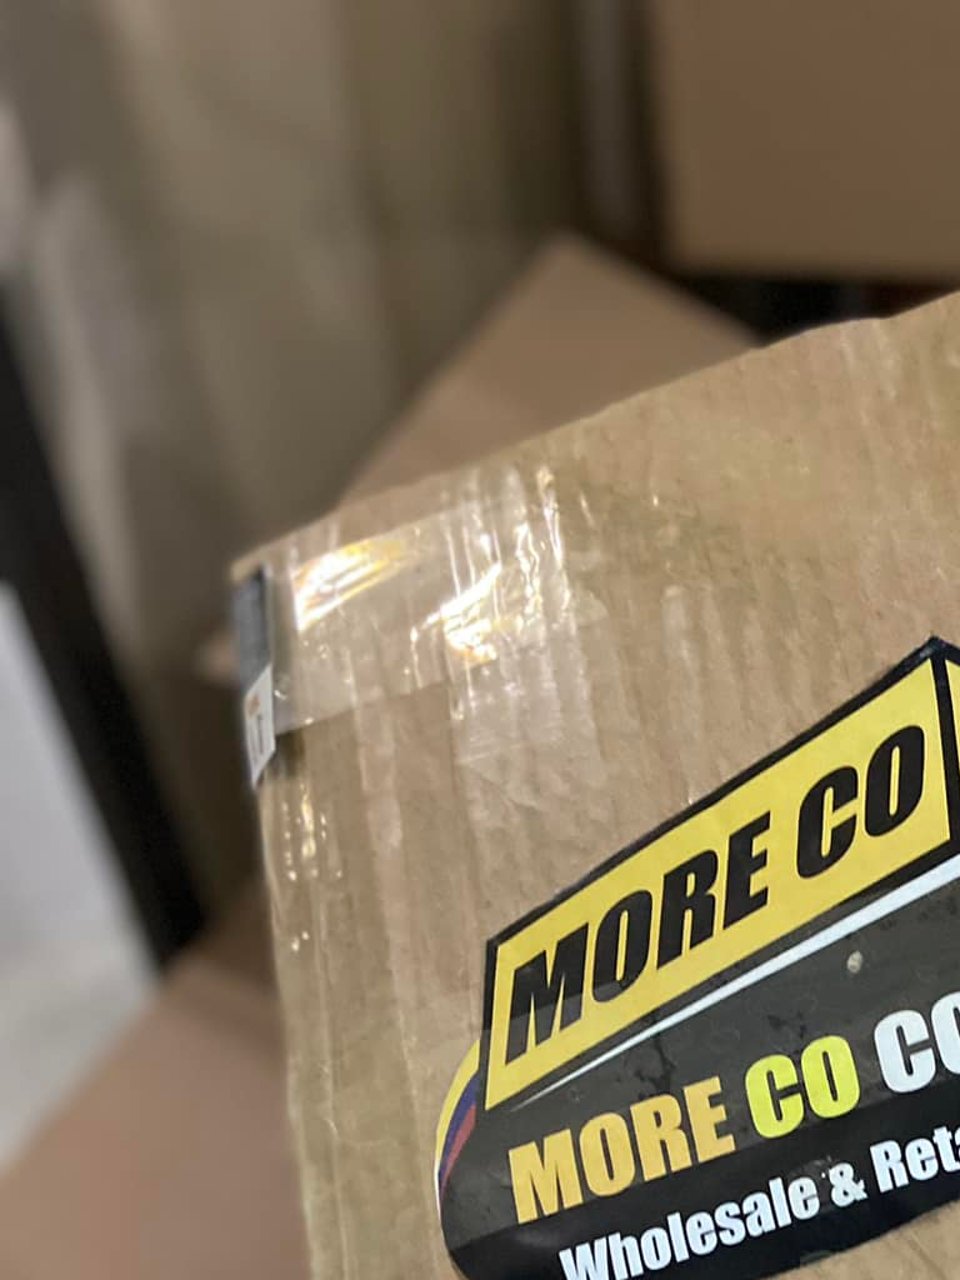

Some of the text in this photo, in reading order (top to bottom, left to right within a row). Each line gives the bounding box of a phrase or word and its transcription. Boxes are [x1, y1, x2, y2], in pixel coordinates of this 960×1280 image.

[505, 724, 926, 1064] MORE CO
[508, 1076, 736, 1224] MORE
[745, 1035, 860, 1138] CO
[828, 1161, 869, 1208] &
